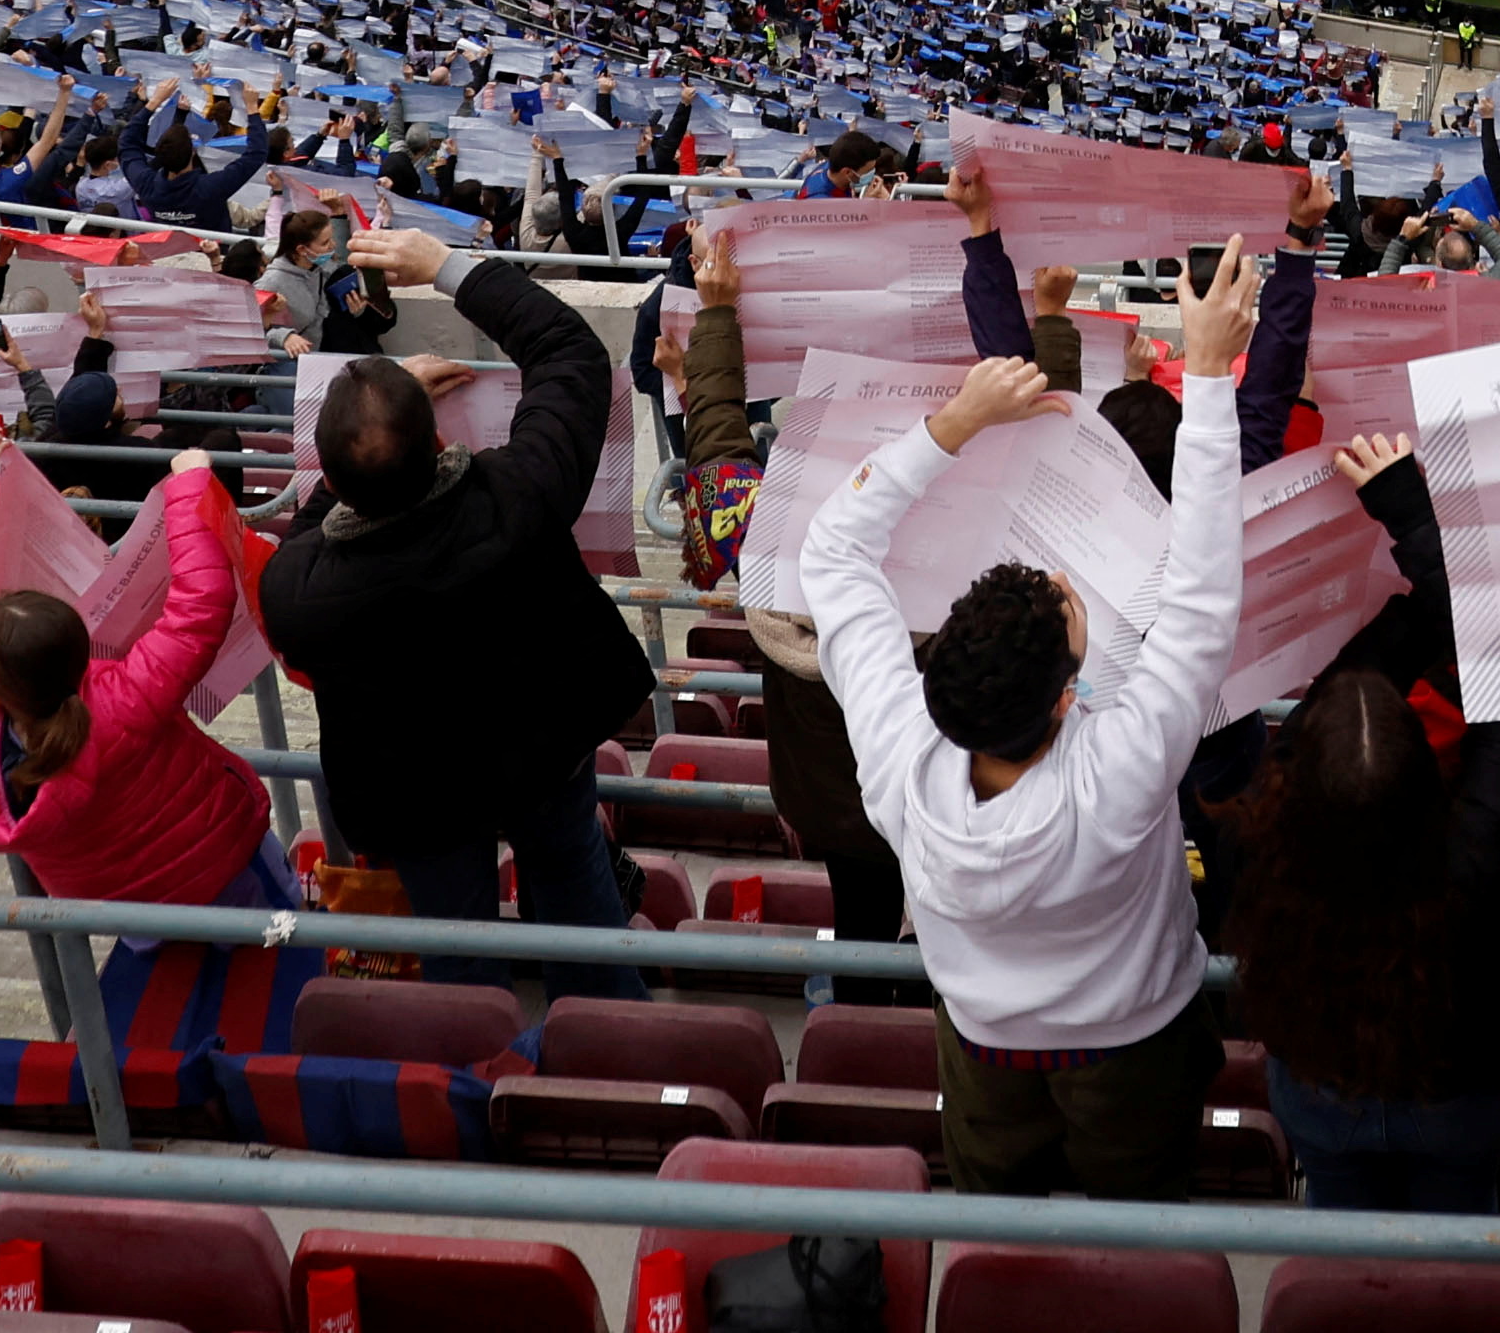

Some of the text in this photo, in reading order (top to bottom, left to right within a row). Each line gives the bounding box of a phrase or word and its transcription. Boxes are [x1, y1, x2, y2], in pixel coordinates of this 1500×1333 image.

[1014, 140, 1112, 161] FC BARCELONA
[773, 213, 869, 224] FC BARCELONA
[1352, 299, 1447, 312] FC BARCELONA
[21, 324, 63, 334] BARCELONA
[887, 385, 909, 396] FC
[1284, 482, 1300, 503] FC
[107, 512, 164, 603] FC BARCELON
